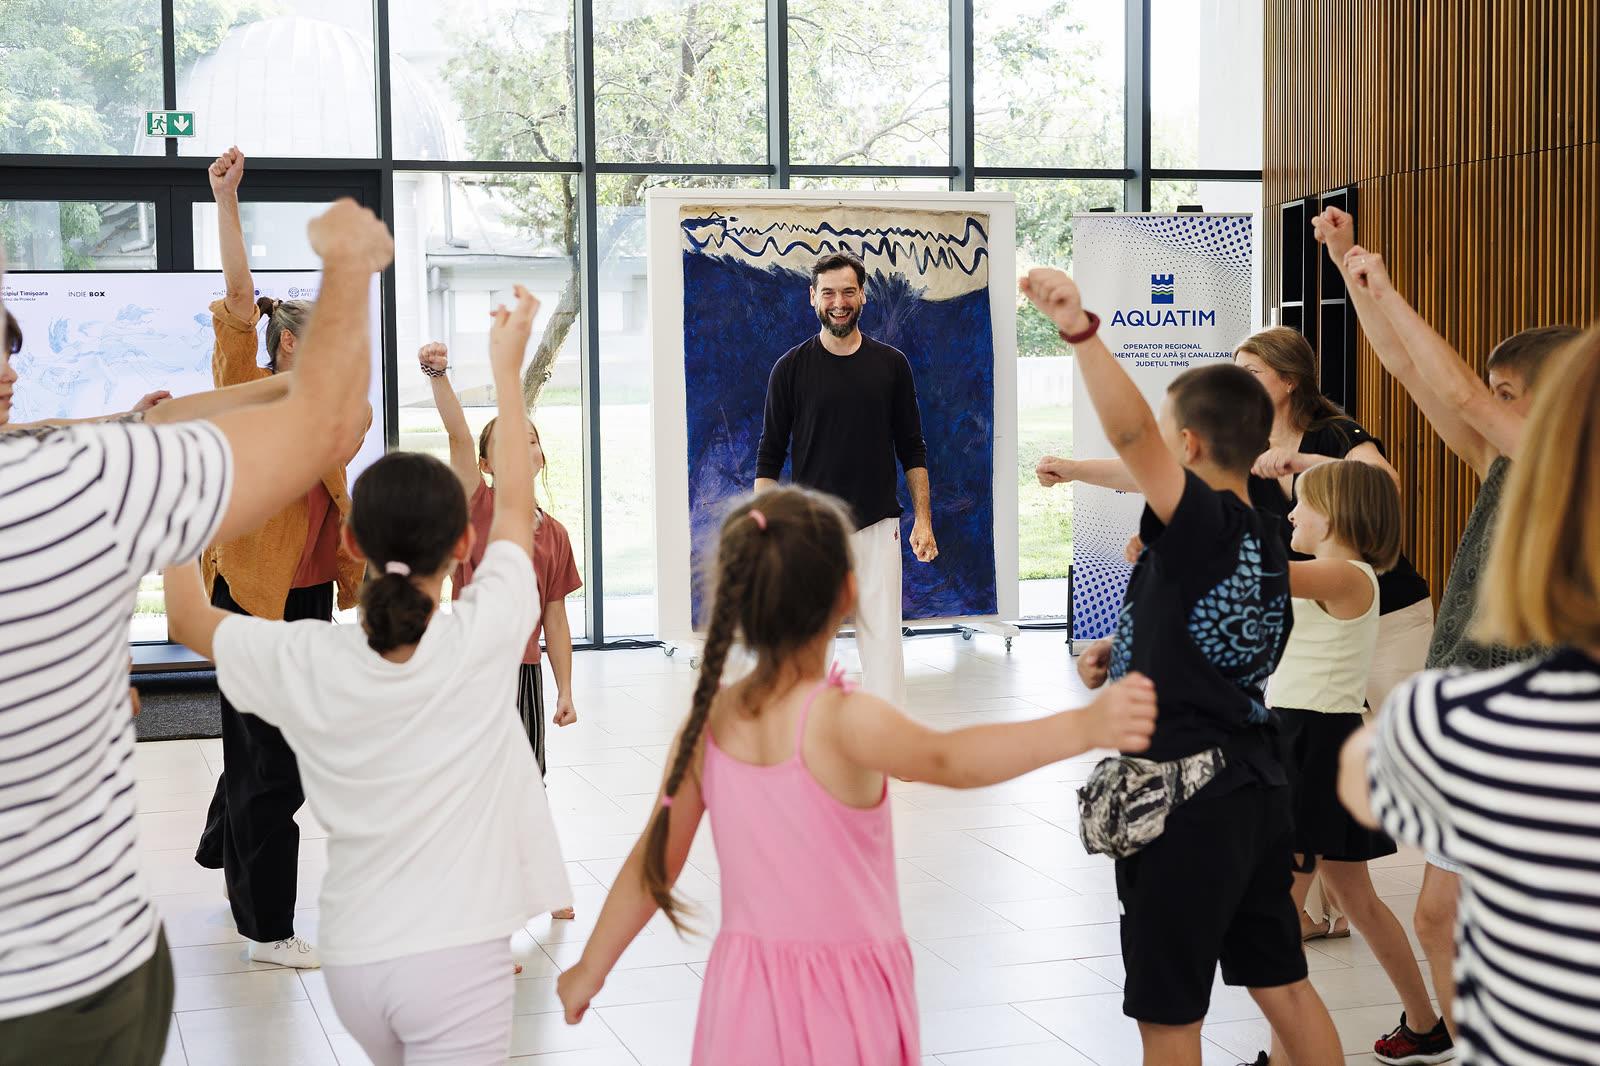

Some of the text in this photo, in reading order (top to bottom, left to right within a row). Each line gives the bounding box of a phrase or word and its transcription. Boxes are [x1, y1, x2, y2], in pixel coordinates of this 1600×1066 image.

[1110, 310, 1216, 327] AQUATIM
[1162, 351, 1178, 359] APĂ
[1179, 352, 1187, 360] ȘI
[1135, 360, 1190, 368] JUDEȚUL TIMIȘ
